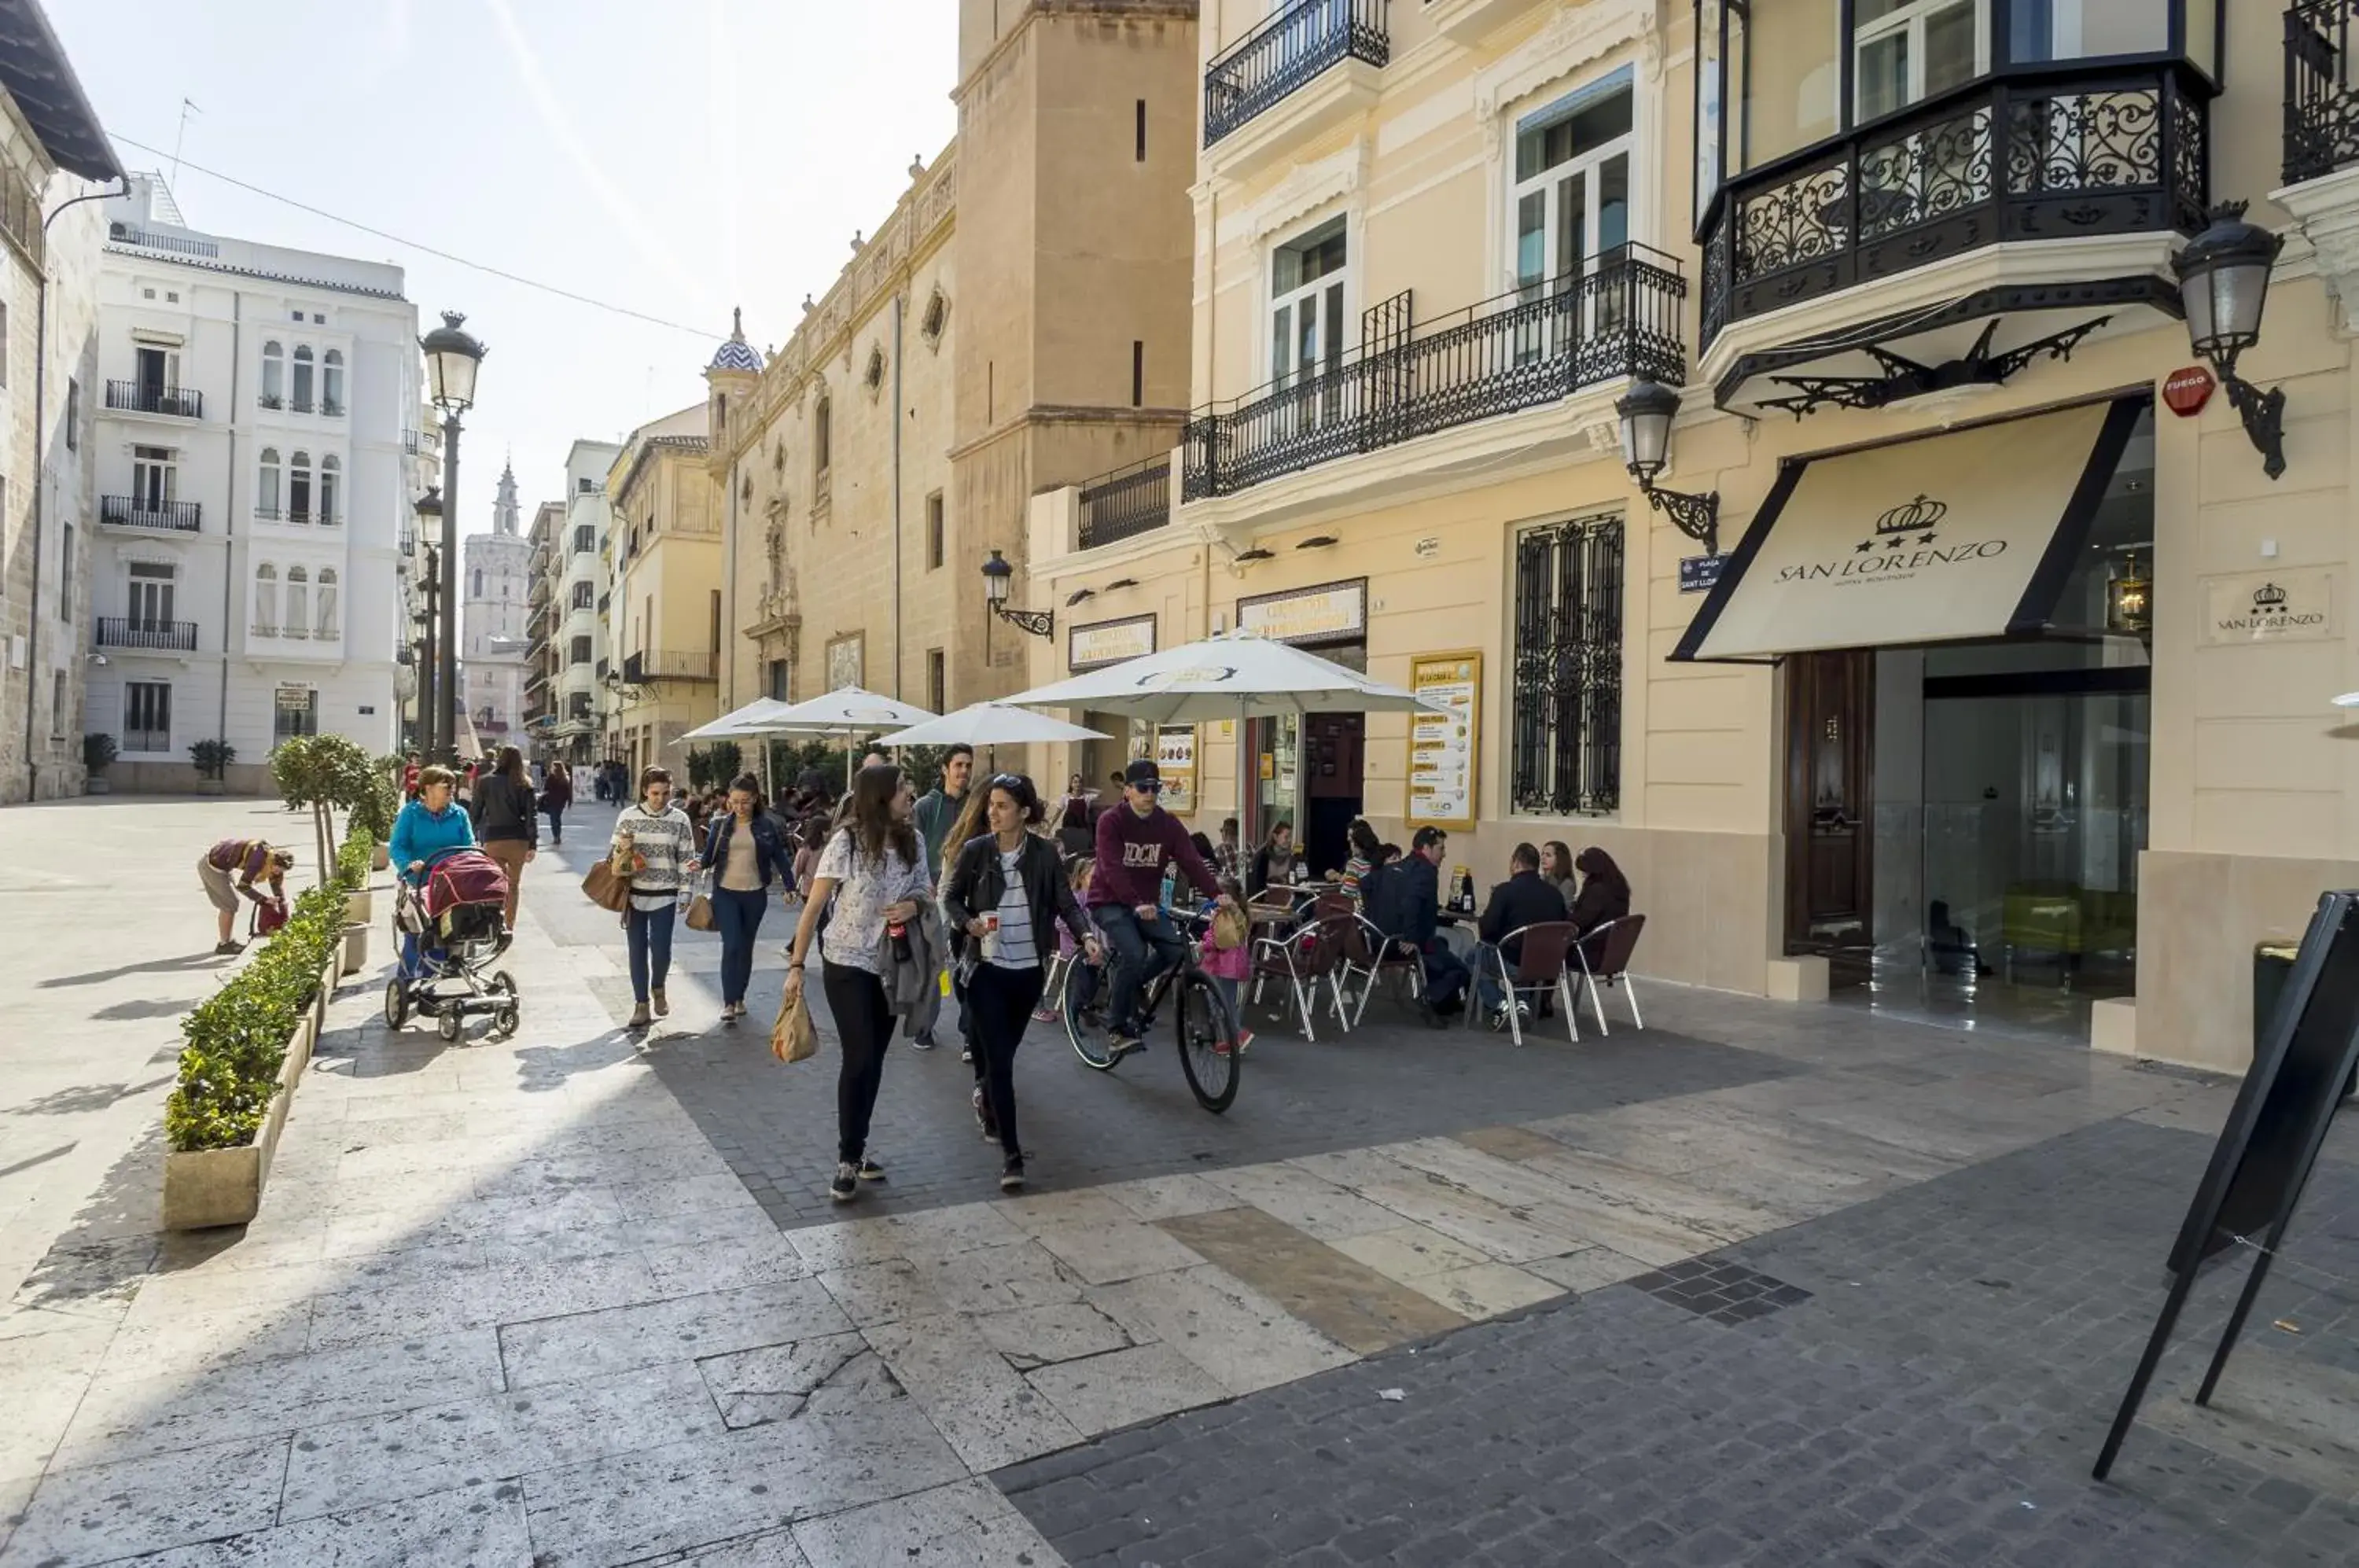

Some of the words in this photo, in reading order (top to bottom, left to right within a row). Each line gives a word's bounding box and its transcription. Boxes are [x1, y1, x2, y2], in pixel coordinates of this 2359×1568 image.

[2166, 376, 2205, 391] FUEGO
[1774, 561, 1837, 583] SAN
[1841, 539, 2008, 576] LORENZO
[2217, 619, 2247, 630] SAN
[2249, 613, 2324, 629] LORENZO
